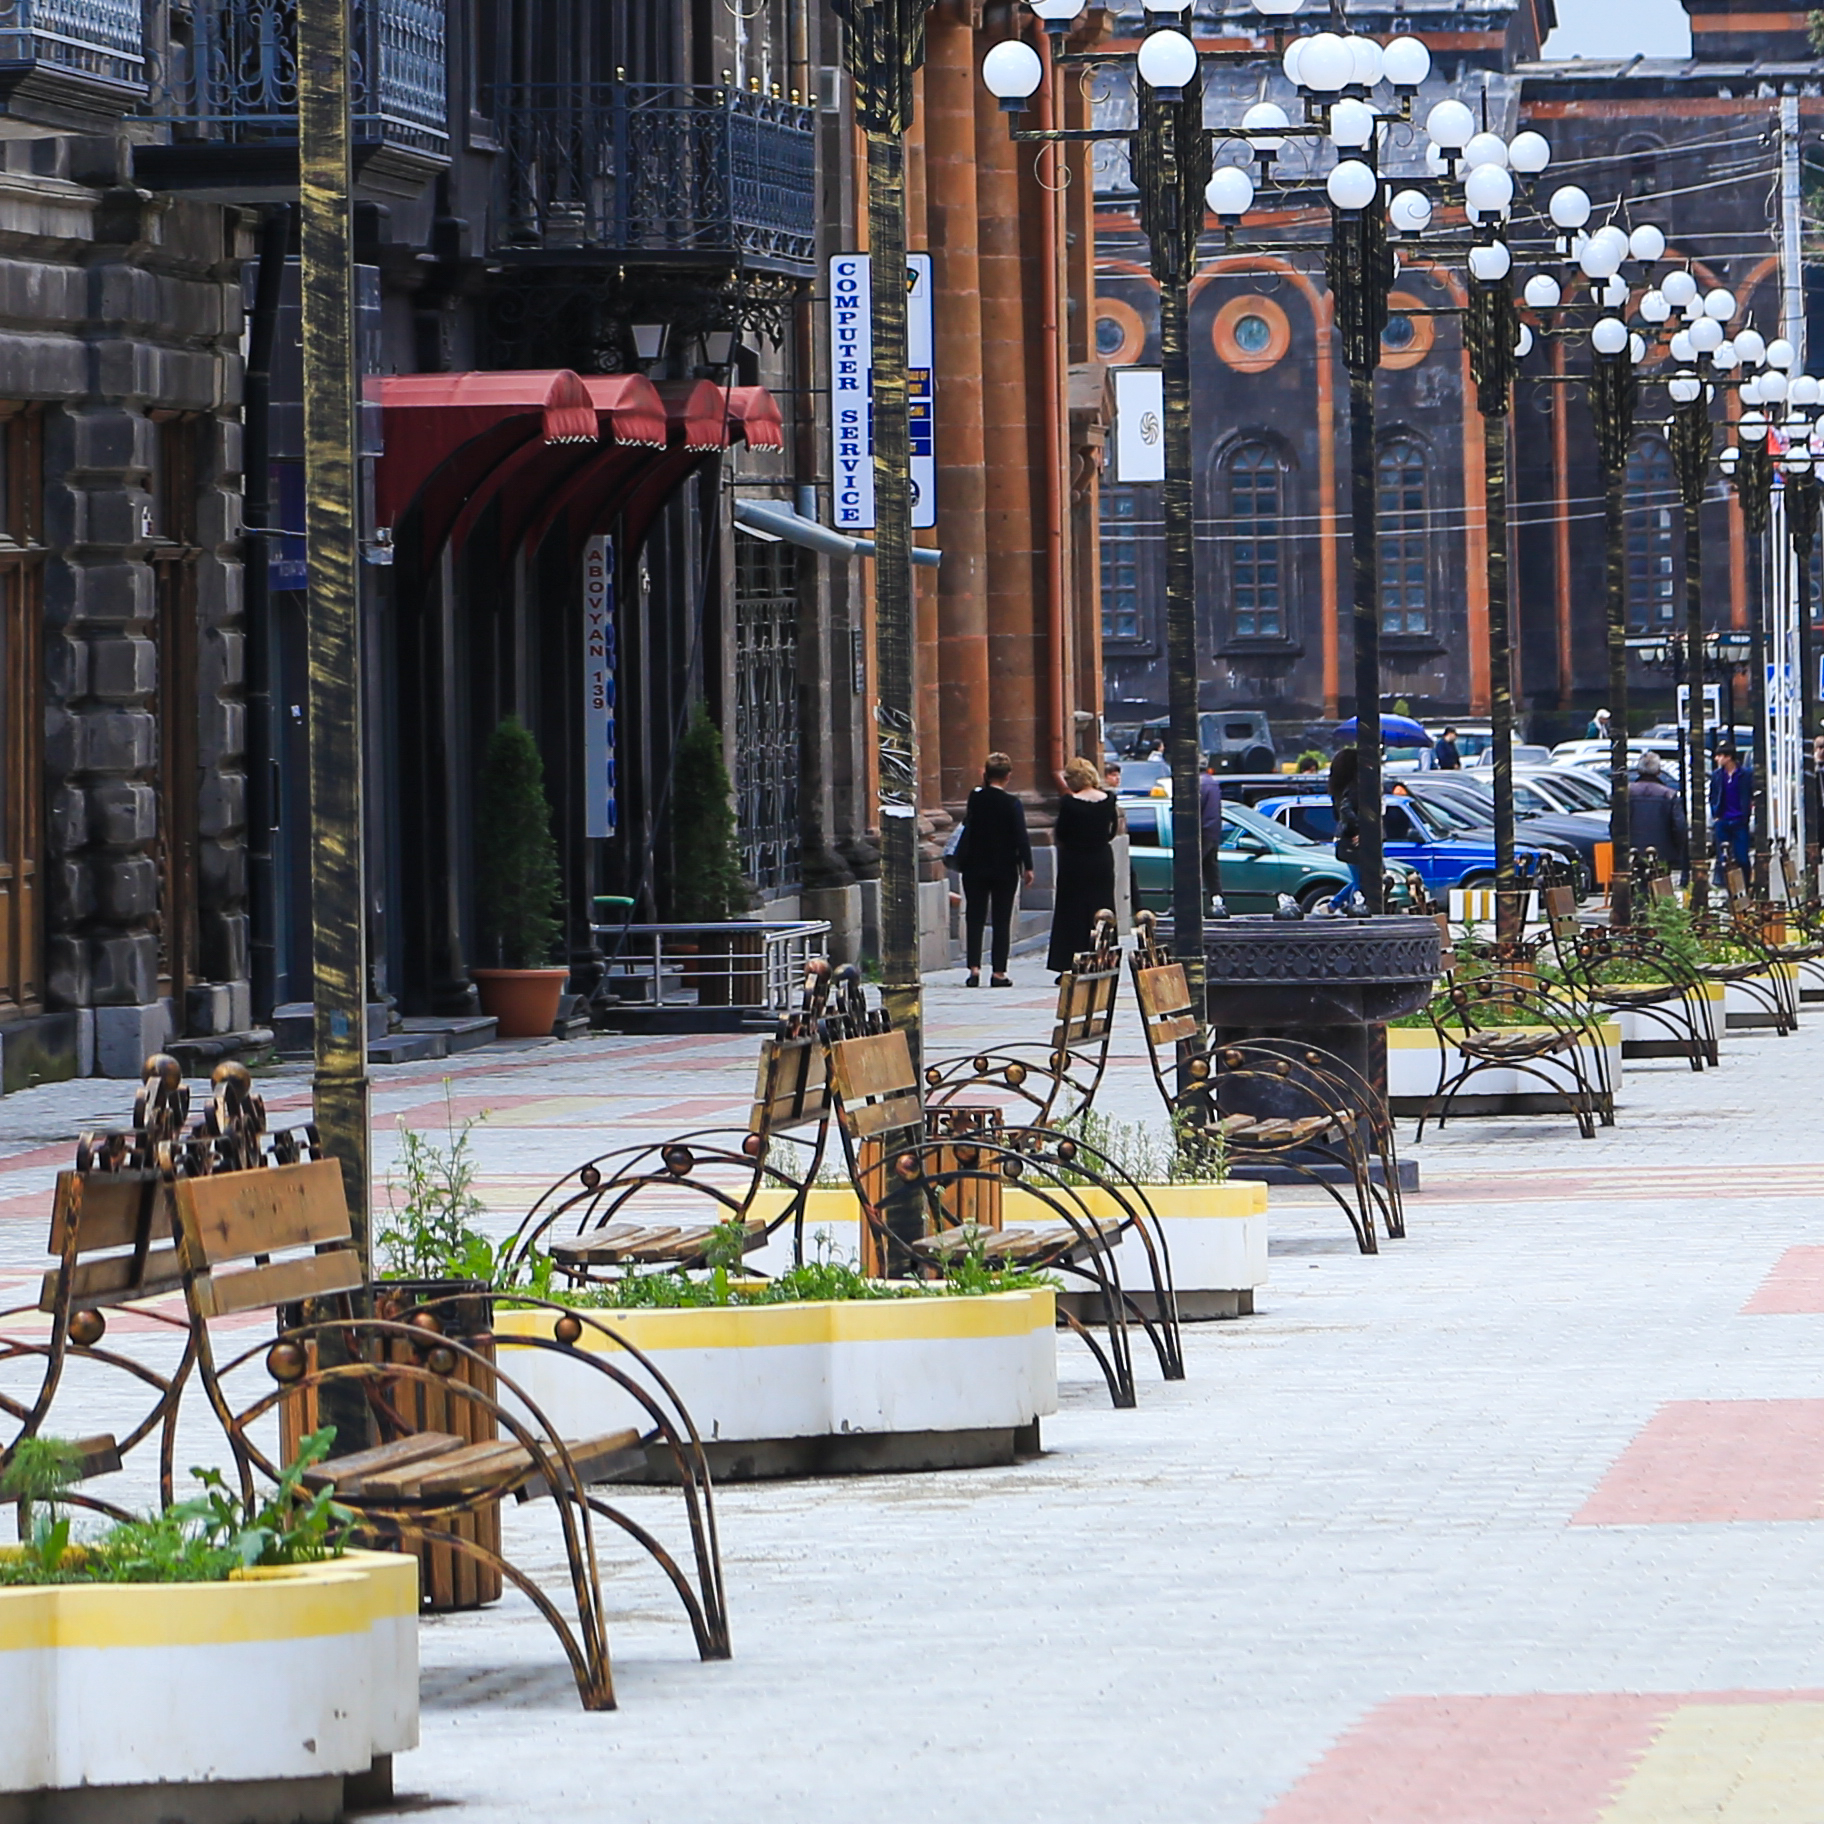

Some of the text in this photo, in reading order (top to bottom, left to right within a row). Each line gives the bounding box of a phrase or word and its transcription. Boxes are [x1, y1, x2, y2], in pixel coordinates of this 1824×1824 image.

[834, 262, 861, 522] COMPUTER SERVICE
[588, 549, 605, 710] ABOVYAN 139
